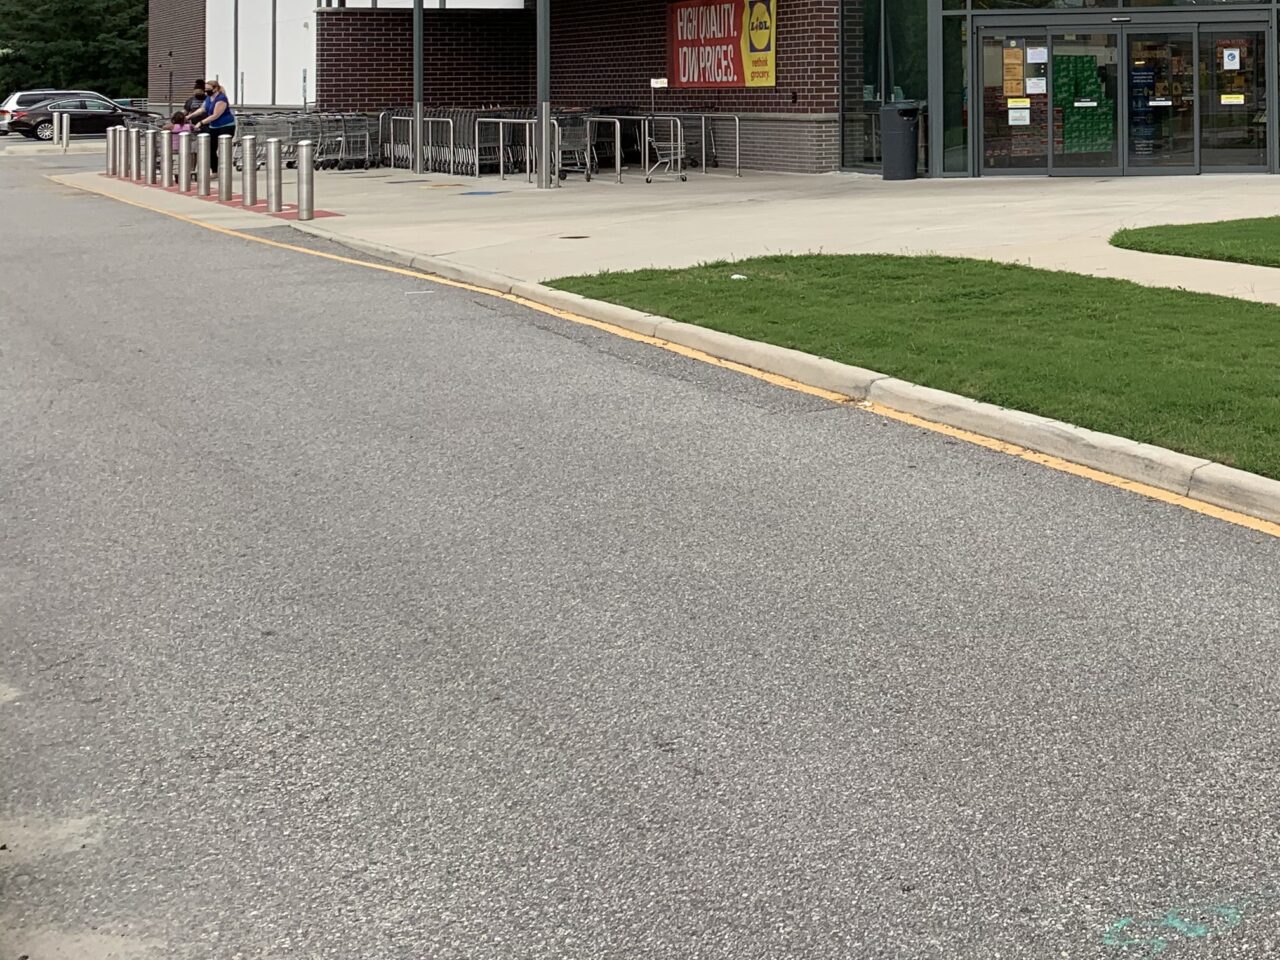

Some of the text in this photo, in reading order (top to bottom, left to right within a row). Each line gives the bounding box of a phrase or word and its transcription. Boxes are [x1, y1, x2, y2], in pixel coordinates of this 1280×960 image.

[677, 3, 737, 44] HIGH QUALITY.
[700, 44, 737, 82] PRICES.
